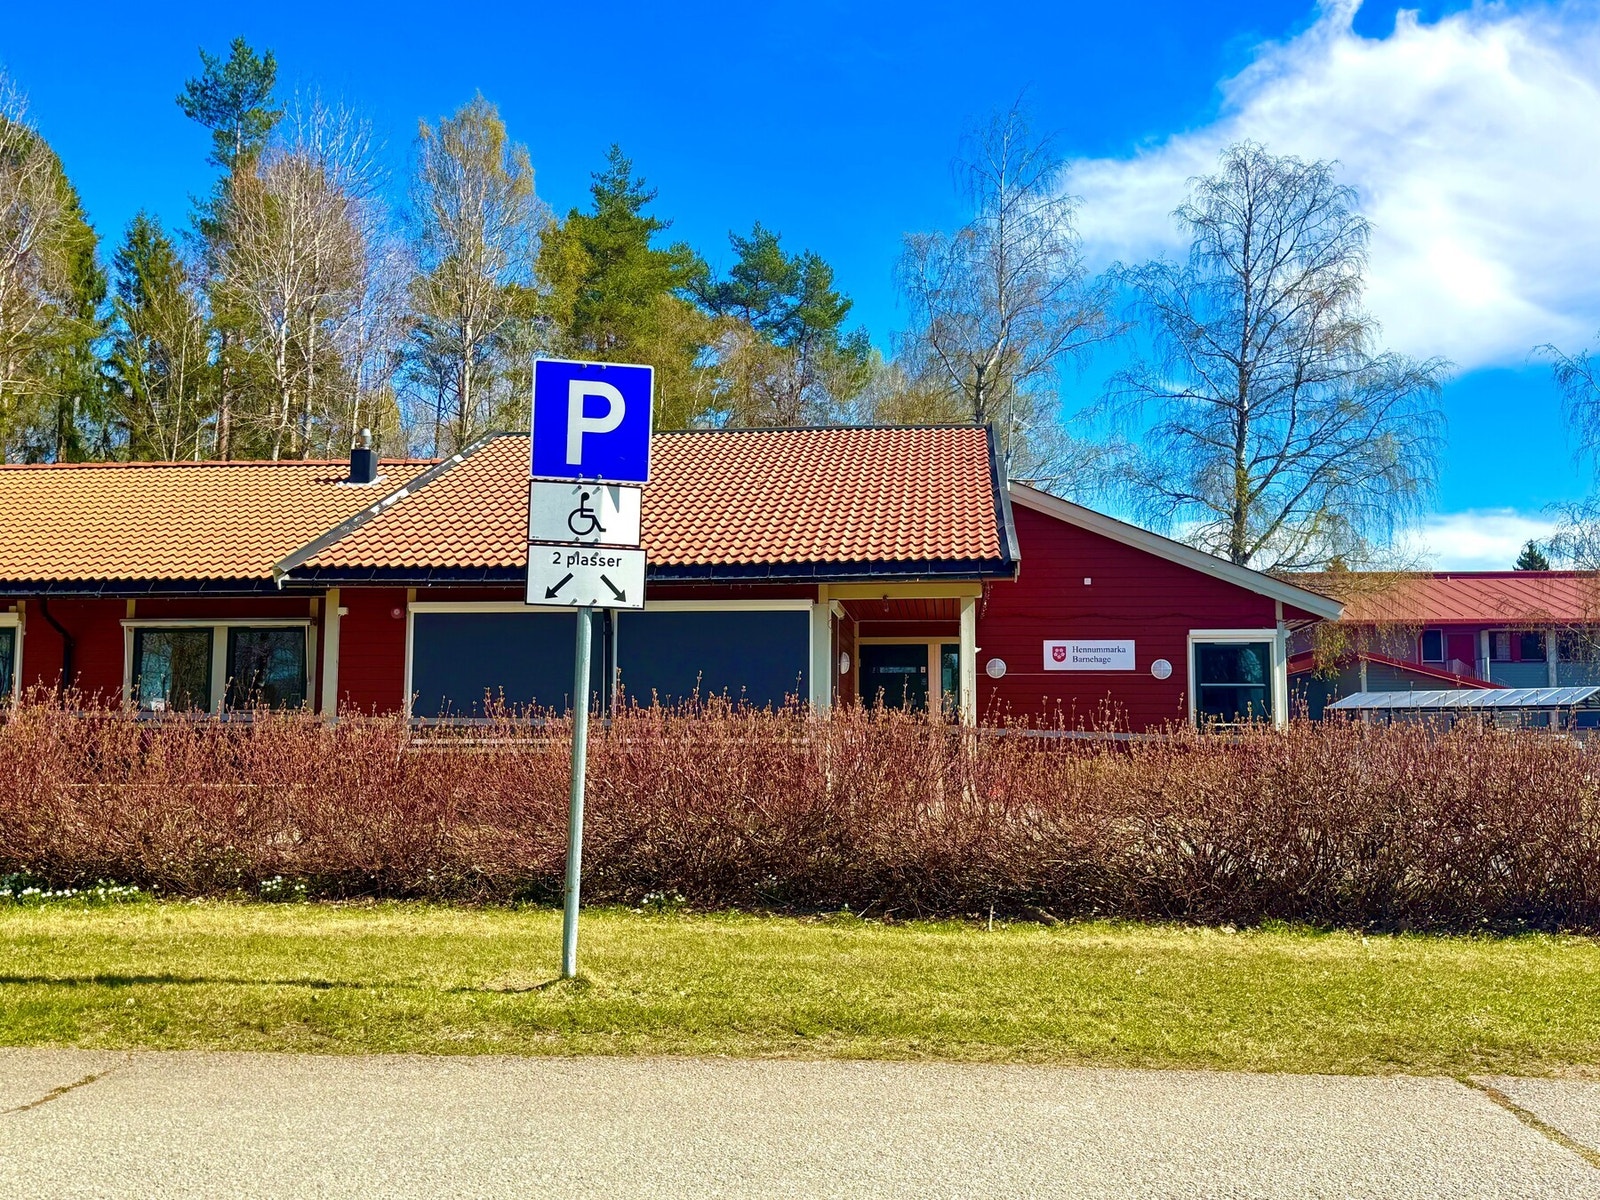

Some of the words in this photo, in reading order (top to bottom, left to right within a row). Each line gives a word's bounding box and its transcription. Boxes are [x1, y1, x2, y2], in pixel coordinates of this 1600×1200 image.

[566, 379, 626, 465] P
[552, 551, 561, 565] 2
[567, 551, 622, 568] plasser
[1072, 645, 1126, 654] Hennummarka
[1072, 655, 1111, 664] Barnehage
